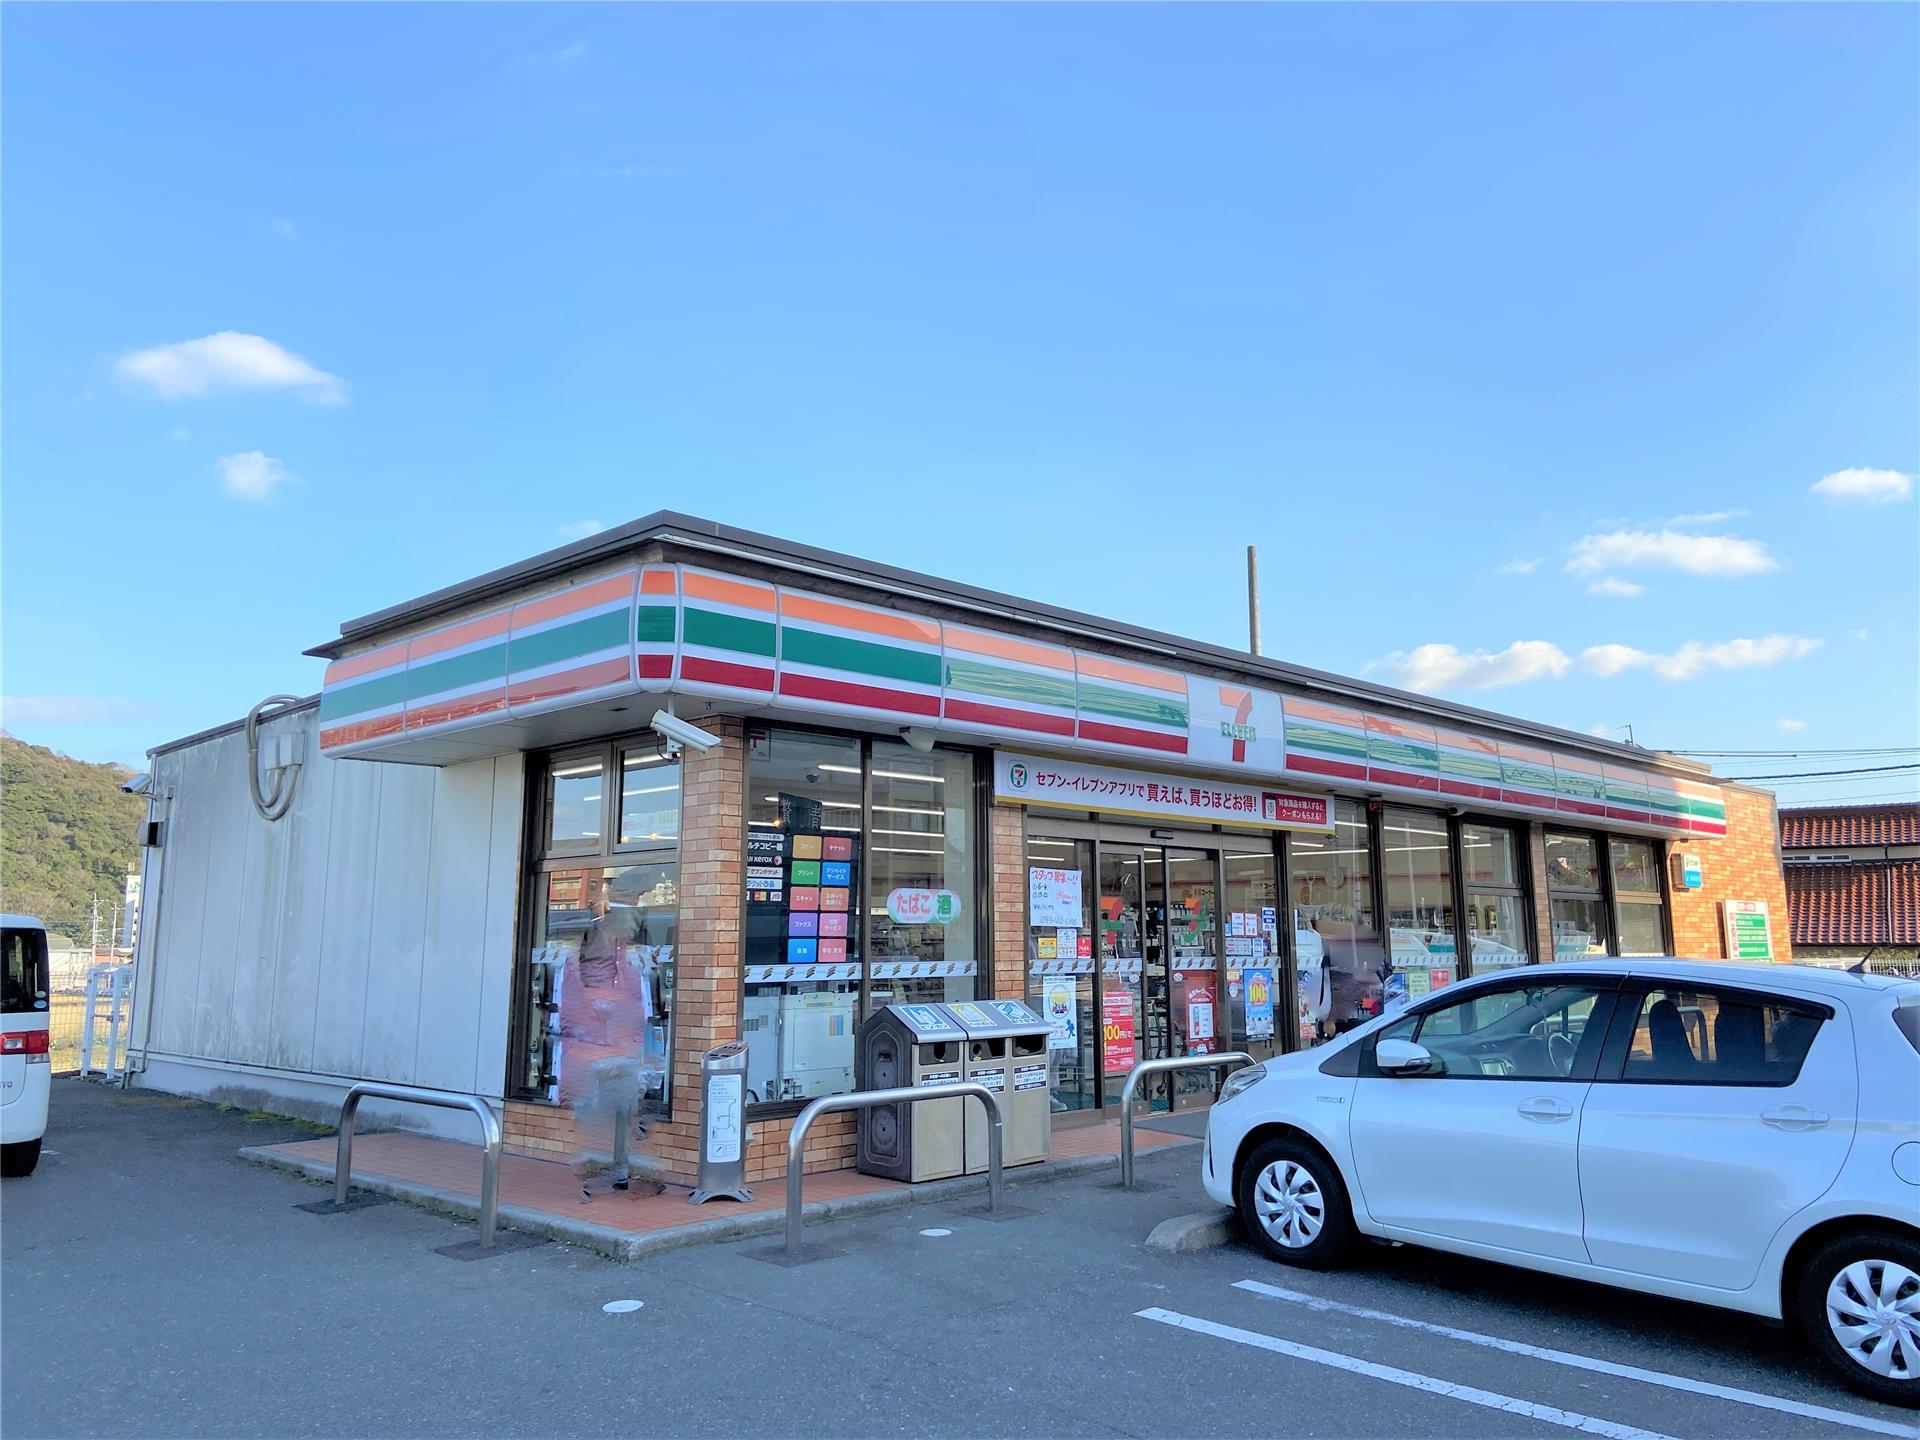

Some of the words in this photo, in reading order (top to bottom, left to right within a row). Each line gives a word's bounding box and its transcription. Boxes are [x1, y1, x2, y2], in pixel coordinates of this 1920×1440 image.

[896, 894, 931, 914] たばこ
[937, 894, 952, 915] 酒
